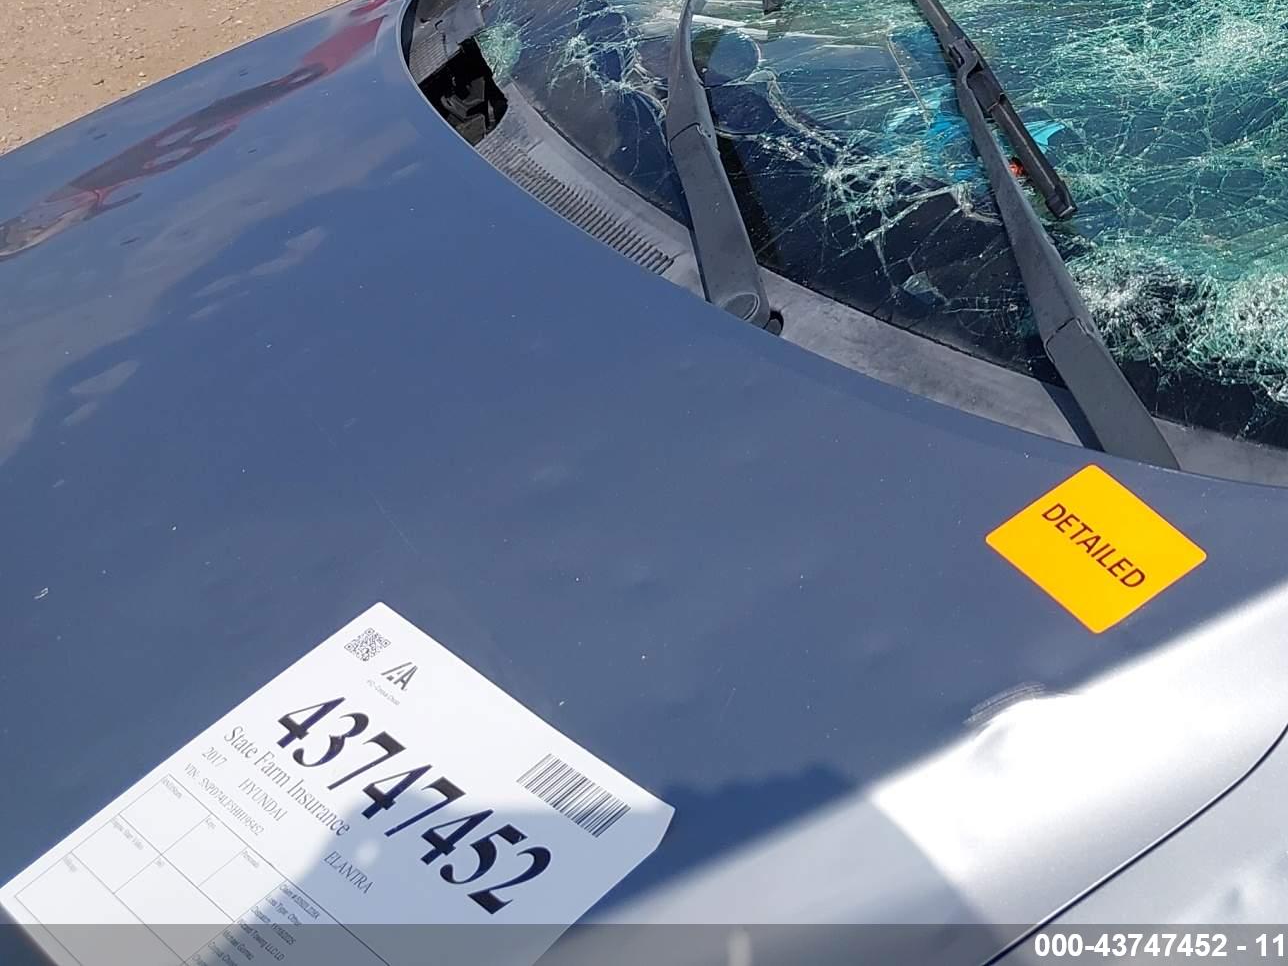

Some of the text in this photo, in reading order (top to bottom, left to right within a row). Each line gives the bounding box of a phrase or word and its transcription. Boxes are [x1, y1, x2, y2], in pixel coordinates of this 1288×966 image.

[1041, 503, 1146, 588] DETAILED
[201, 746, 375, 894] 2017 HYUNDAI ELANTRA
[224, 725, 351, 836] State Farm Insurance
[277, 697, 552, 915] 43747452
